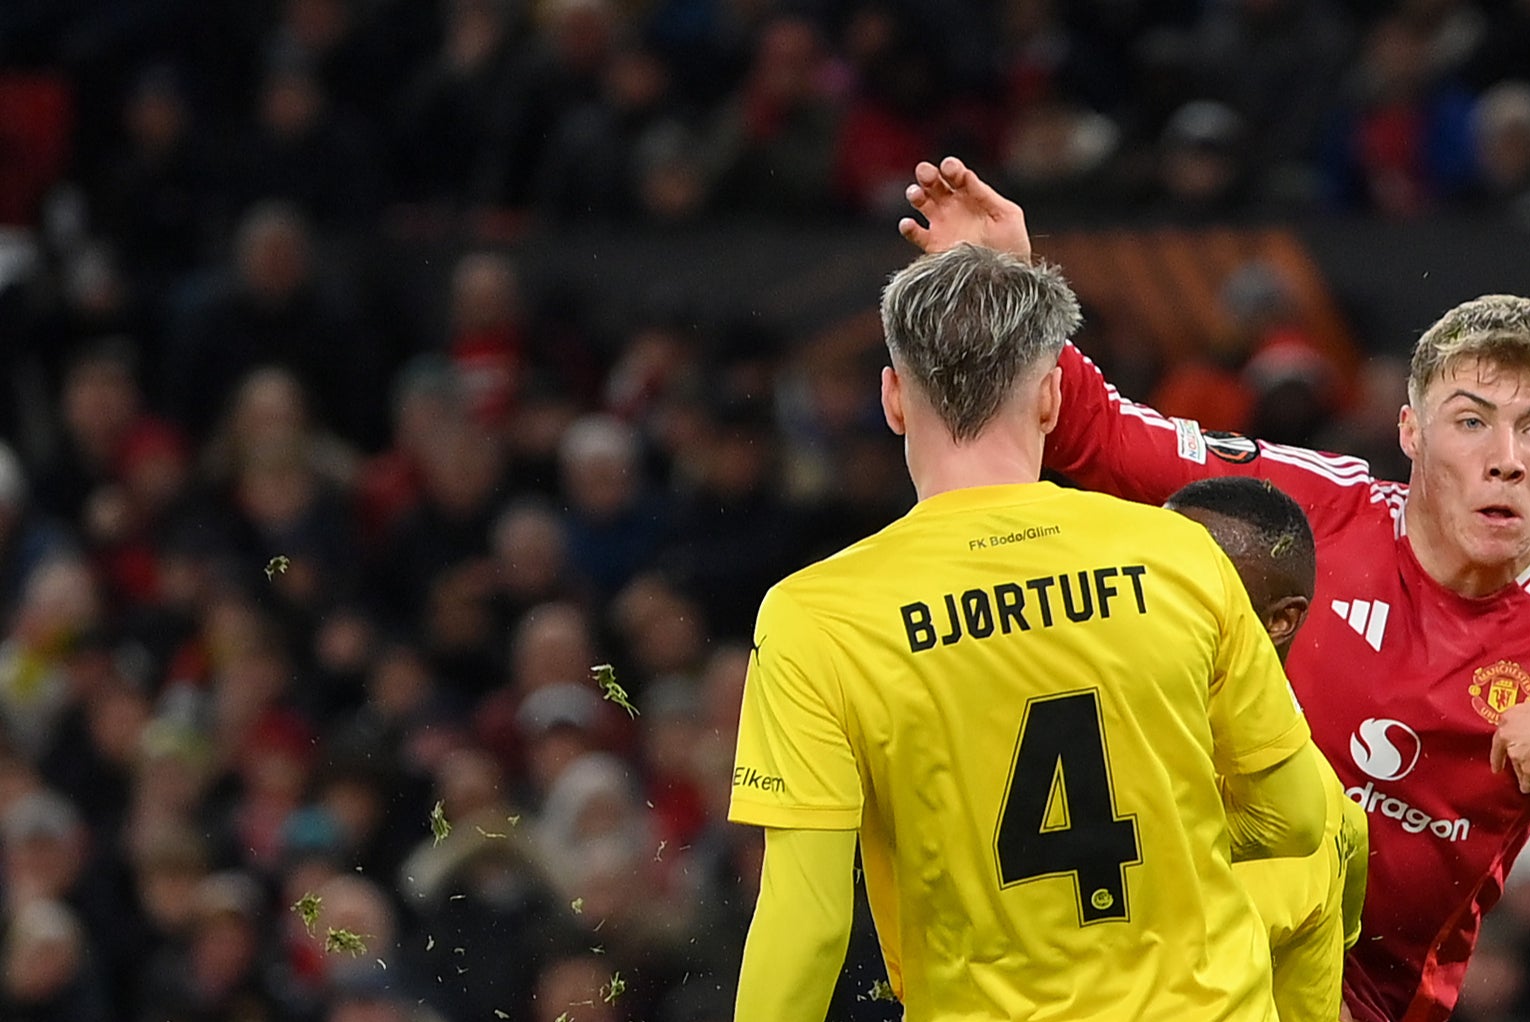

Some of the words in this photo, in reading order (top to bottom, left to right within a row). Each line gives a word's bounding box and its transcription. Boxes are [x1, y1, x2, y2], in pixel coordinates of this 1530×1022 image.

[968, 538, 987, 551] FK
[900, 565, 1148, 653] BJØRTUFT
[733, 767, 785, 792] Elkem
[994, 686, 1143, 928] 4
[1345, 781, 1470, 842] dragon
